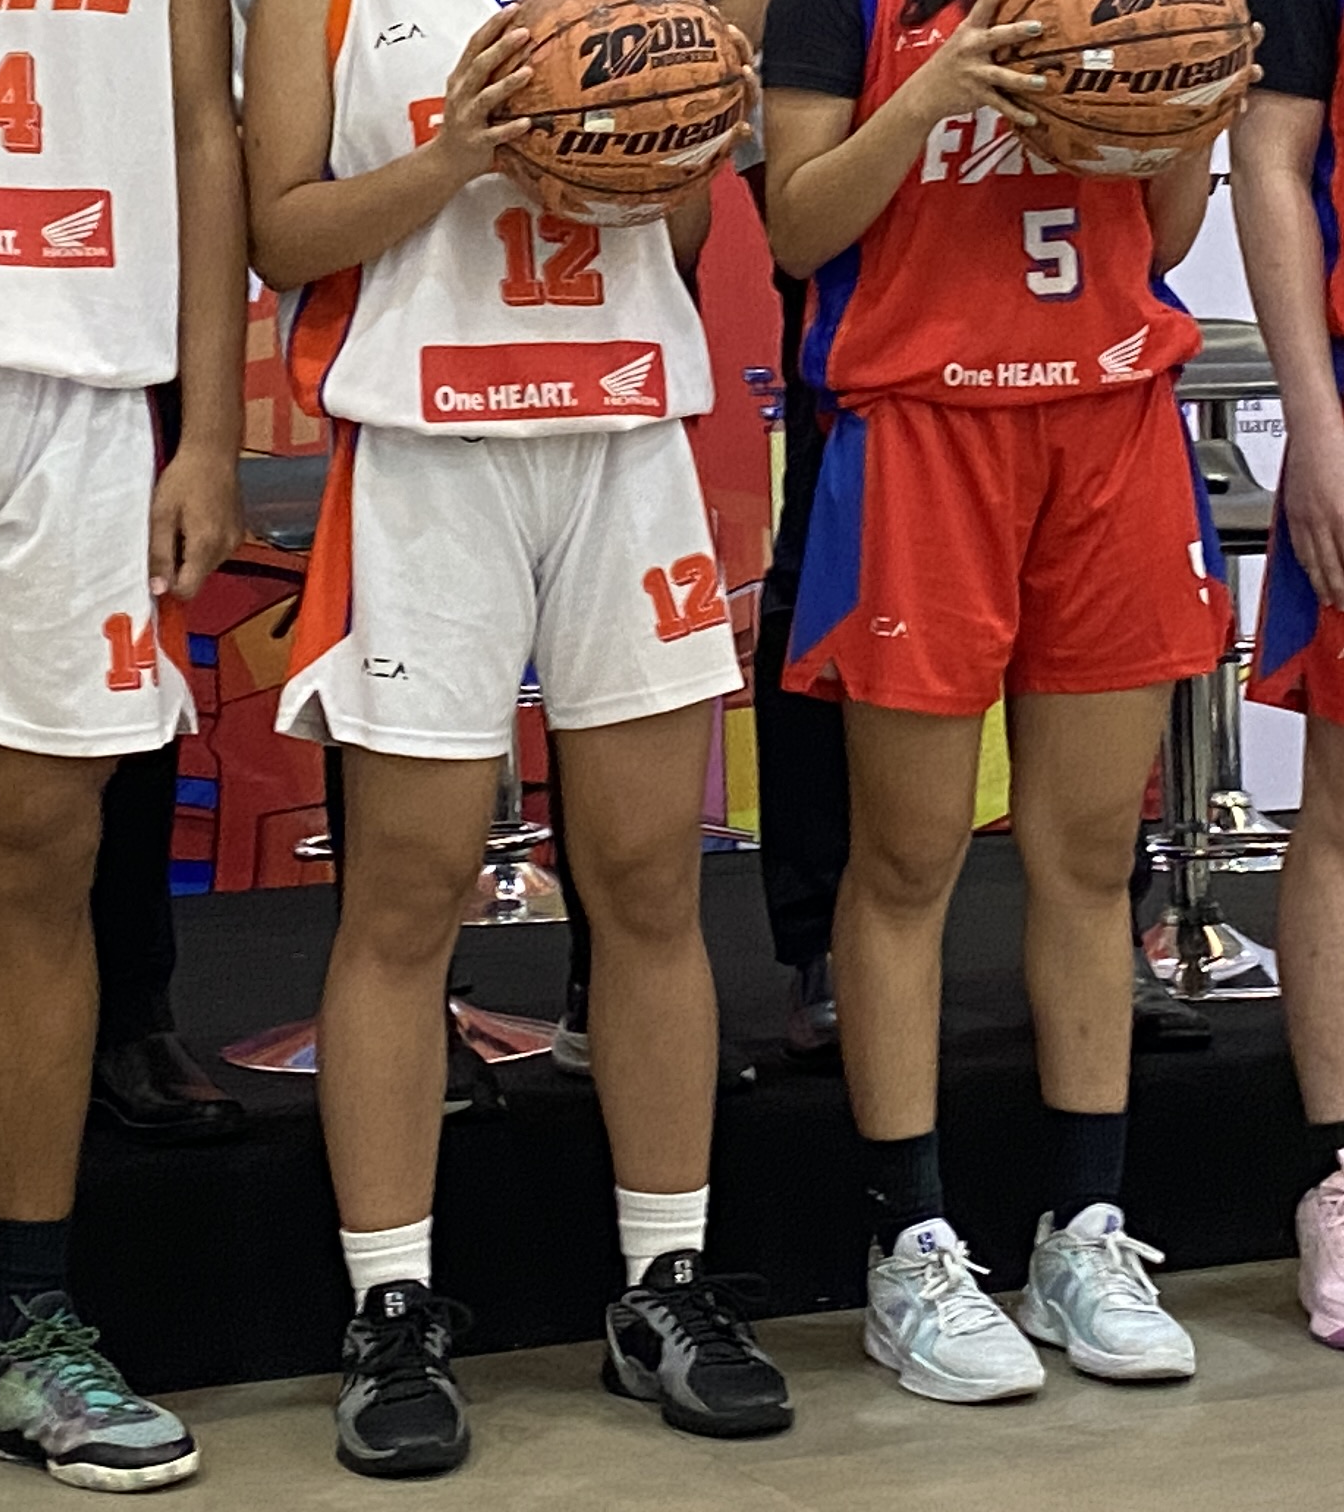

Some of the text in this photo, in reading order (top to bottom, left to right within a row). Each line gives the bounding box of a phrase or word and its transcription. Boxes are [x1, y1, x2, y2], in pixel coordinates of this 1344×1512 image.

[494, 207, 605, 307] 12
[1022, 207, 1084, 300] 5
[434, 385, 485, 412] One
[943, 362, 993, 387] One
[641, 552, 728, 643] 12
